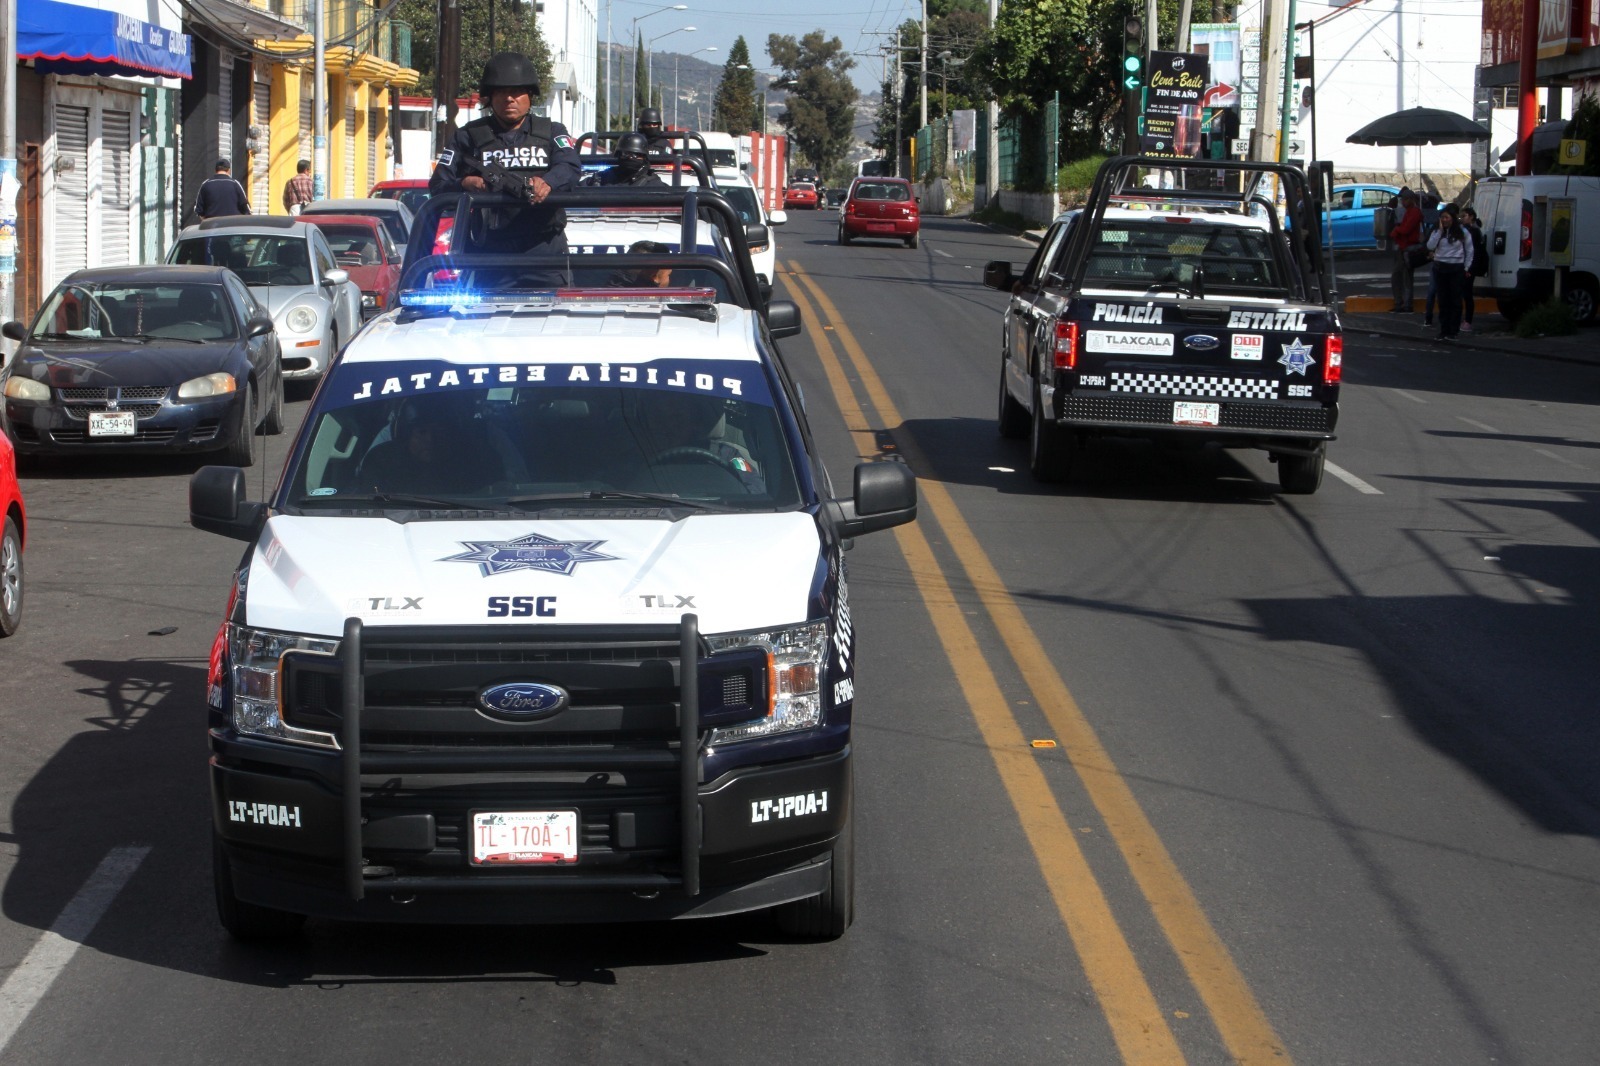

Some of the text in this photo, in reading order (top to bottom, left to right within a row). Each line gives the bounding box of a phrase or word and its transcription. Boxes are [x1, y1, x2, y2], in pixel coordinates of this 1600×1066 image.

[1156, 89, 1198, 98] FIN DE AÑO
[483, 146, 547, 161] POLICÍA
[483, 157, 548, 168] ETATAL
[1093, 301, 1308, 331] POLICÍA ESTATAL
[1106, 335, 1171, 347] TLAXCALA
[1235, 337, 1259, 345] 911
[1288, 385, 1312, 397] SSC
[368, 597, 424, 610] TLX
[488, 596, 557, 617] SSC
[639, 595, 697, 608] TLX
[500, 690, 543, 708] Ford
[478, 825, 572, 847] TL-170A-1
